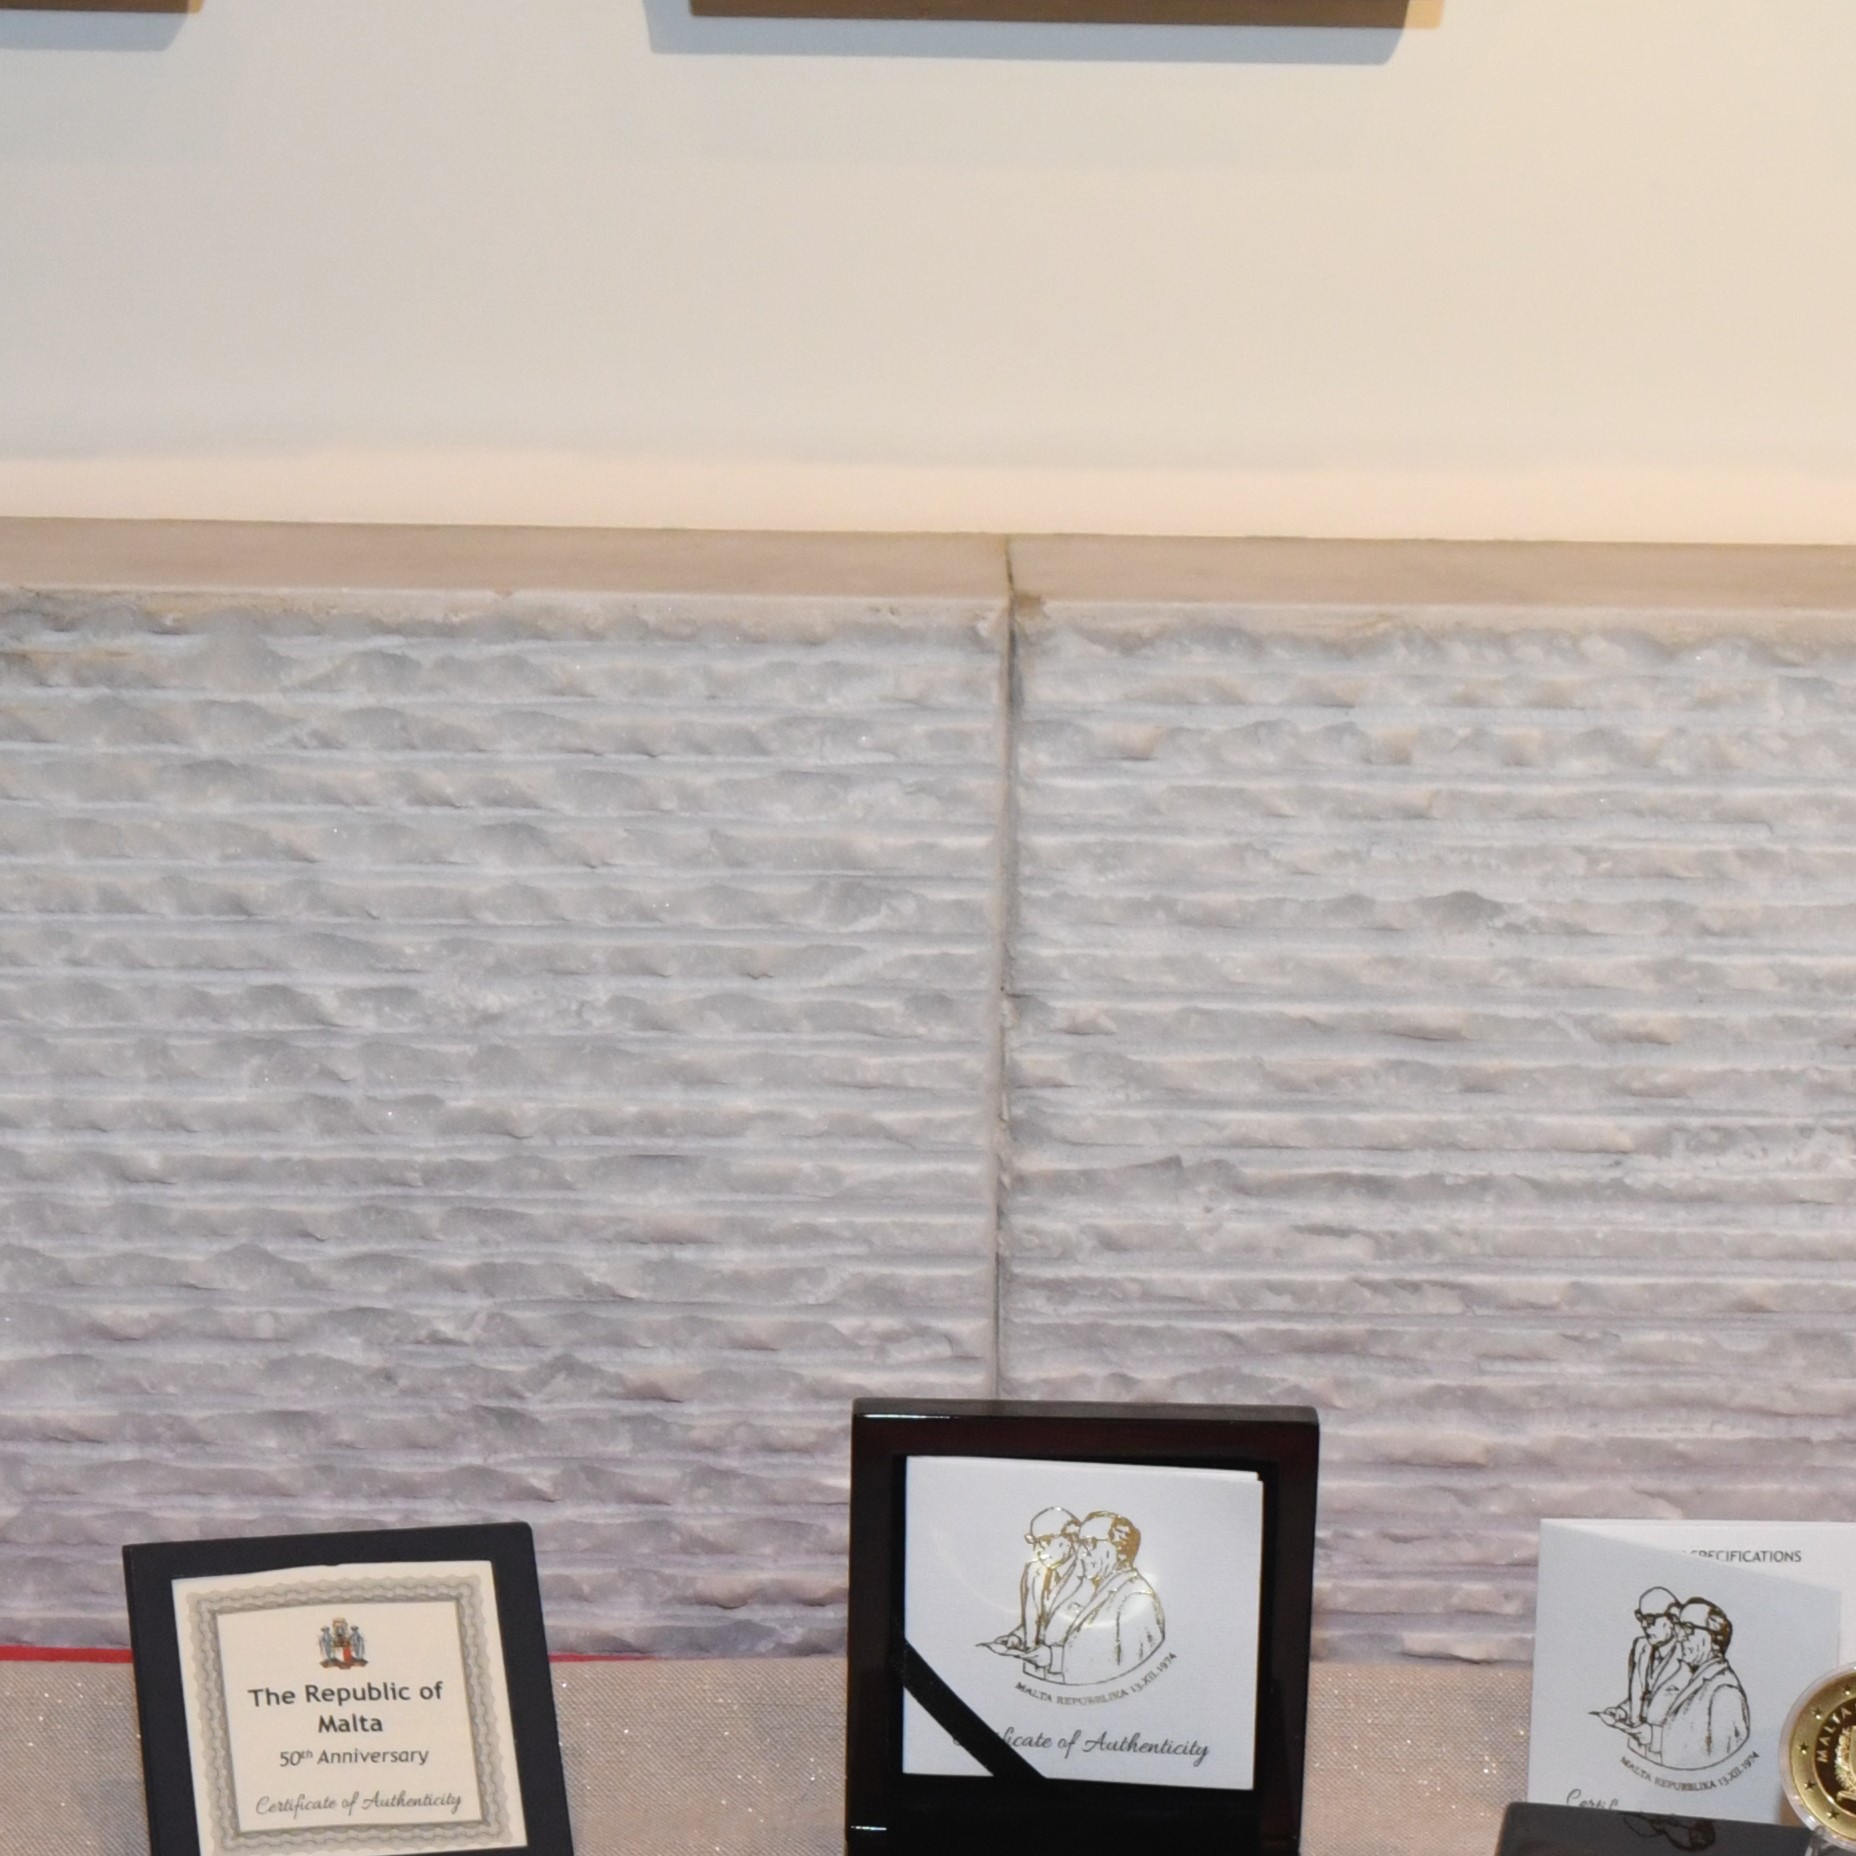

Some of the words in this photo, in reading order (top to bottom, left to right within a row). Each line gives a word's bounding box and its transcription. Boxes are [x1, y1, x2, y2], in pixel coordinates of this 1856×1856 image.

[247, 1688, 296, 1707] The
[305, 1682, 411, 1706] Republic
[420, 1681, 443, 1700] of
[1015, 1682, 1052, 1703] MALTA
[1056, 1689, 1128, 1705] REPUBBLIKA
[318, 1714, 384, 1733] Malta
[1817, 1707, 1852, 1762] MALTA
[280, 1749, 313, 1766] 50th
[318, 1748, 430, 1765] Anniversary
[1058, 1729, 1082, 1760] of
[1082, 1731, 1209, 1767] Authenticity
[1620, 1756, 1652, 1781] MALTA
[1654, 1777, 1716, 1791] REPUBBLIKA
[255, 1794, 337, 1820] Certificate
[342, 1791, 359, 1816] of
[362, 1790, 462, 1814] Authenticity
